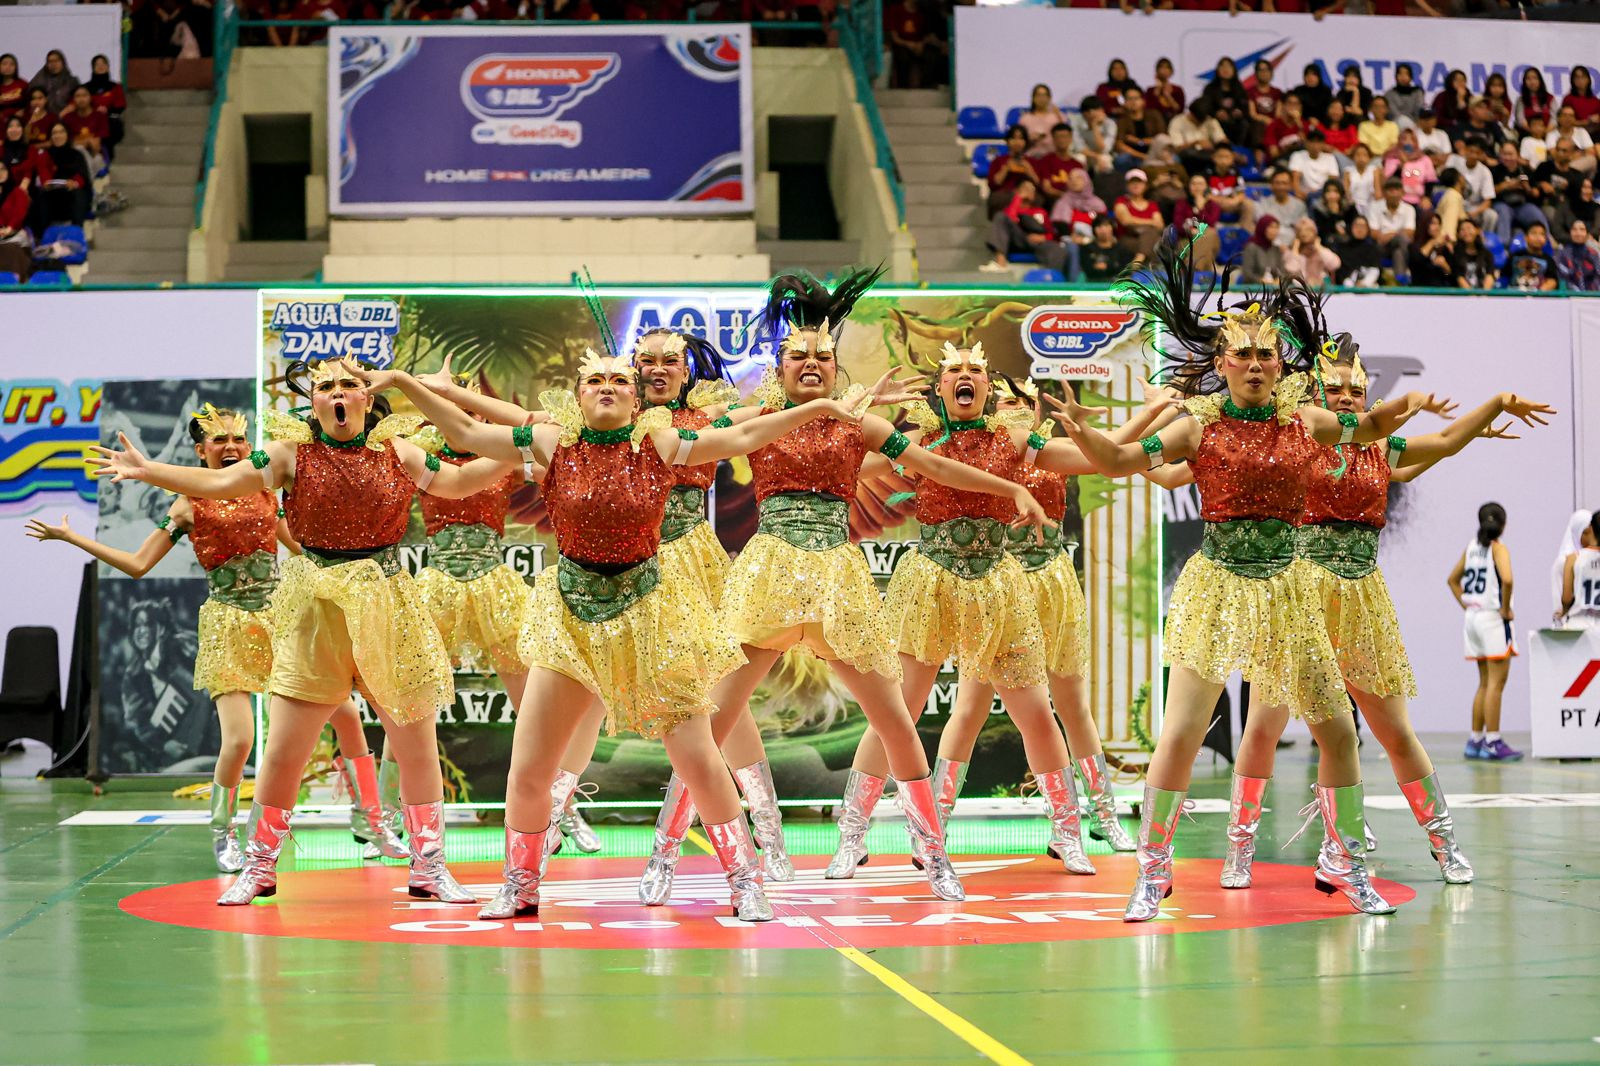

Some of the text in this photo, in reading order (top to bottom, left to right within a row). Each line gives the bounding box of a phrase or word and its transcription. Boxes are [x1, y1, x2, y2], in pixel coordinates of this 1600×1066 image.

[505, 68, 581, 80] HONDA
[425, 169, 488, 182] HOME
[530, 168, 651, 182] DREAMERS
[274, 302, 394, 329] AQUA DBL
[1057, 320, 1113, 330] HONDA
[283, 331, 379, 362] DANCE
[1056, 335, 1085, 349] DBL
[1060, 364, 1088, 375] Good
[1089, 364, 1110, 377] Day
[1464, 568, 1487, 594] 25
[1560, 708, 1587, 728] PT
